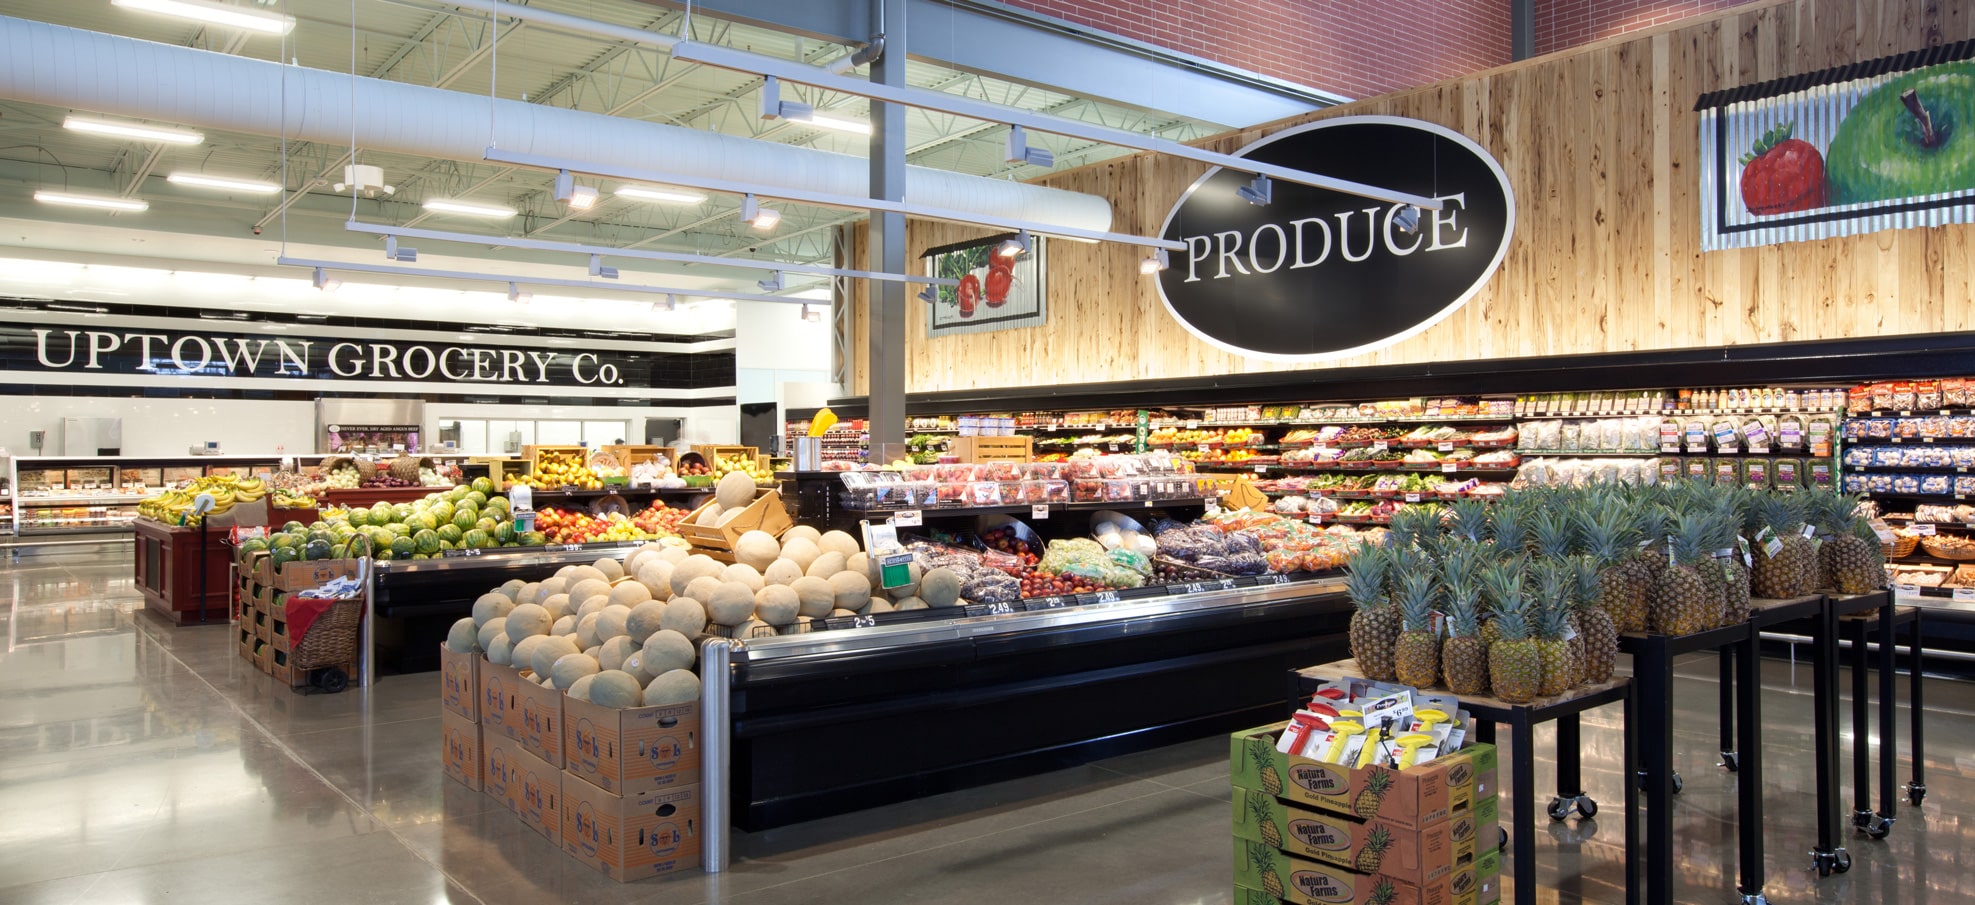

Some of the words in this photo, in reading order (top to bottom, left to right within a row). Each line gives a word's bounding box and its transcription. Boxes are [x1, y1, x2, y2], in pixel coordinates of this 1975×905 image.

[1184, 192, 1468, 282] PRODUCE
[32, 329, 314, 374] UPTOWN
[327, 342, 557, 382] GROCERY
[572, 353, 624, 384] Co.
[1297, 769, 1325, 780] Natura
[1308, 779, 1335, 790] Farms
[1304, 791, 1319, 801] Gold
[1320, 796, 1352, 810] Pineapple
[1296, 824, 1325, 835] Natura
[1308, 834, 1335, 845] Farms
[1305, 847, 1320, 857] Gold
[1321, 851, 1352, 865] Pineapple
[1298, 875, 1329, 887] Natura
[1310, 885, 1338, 897] Farms
